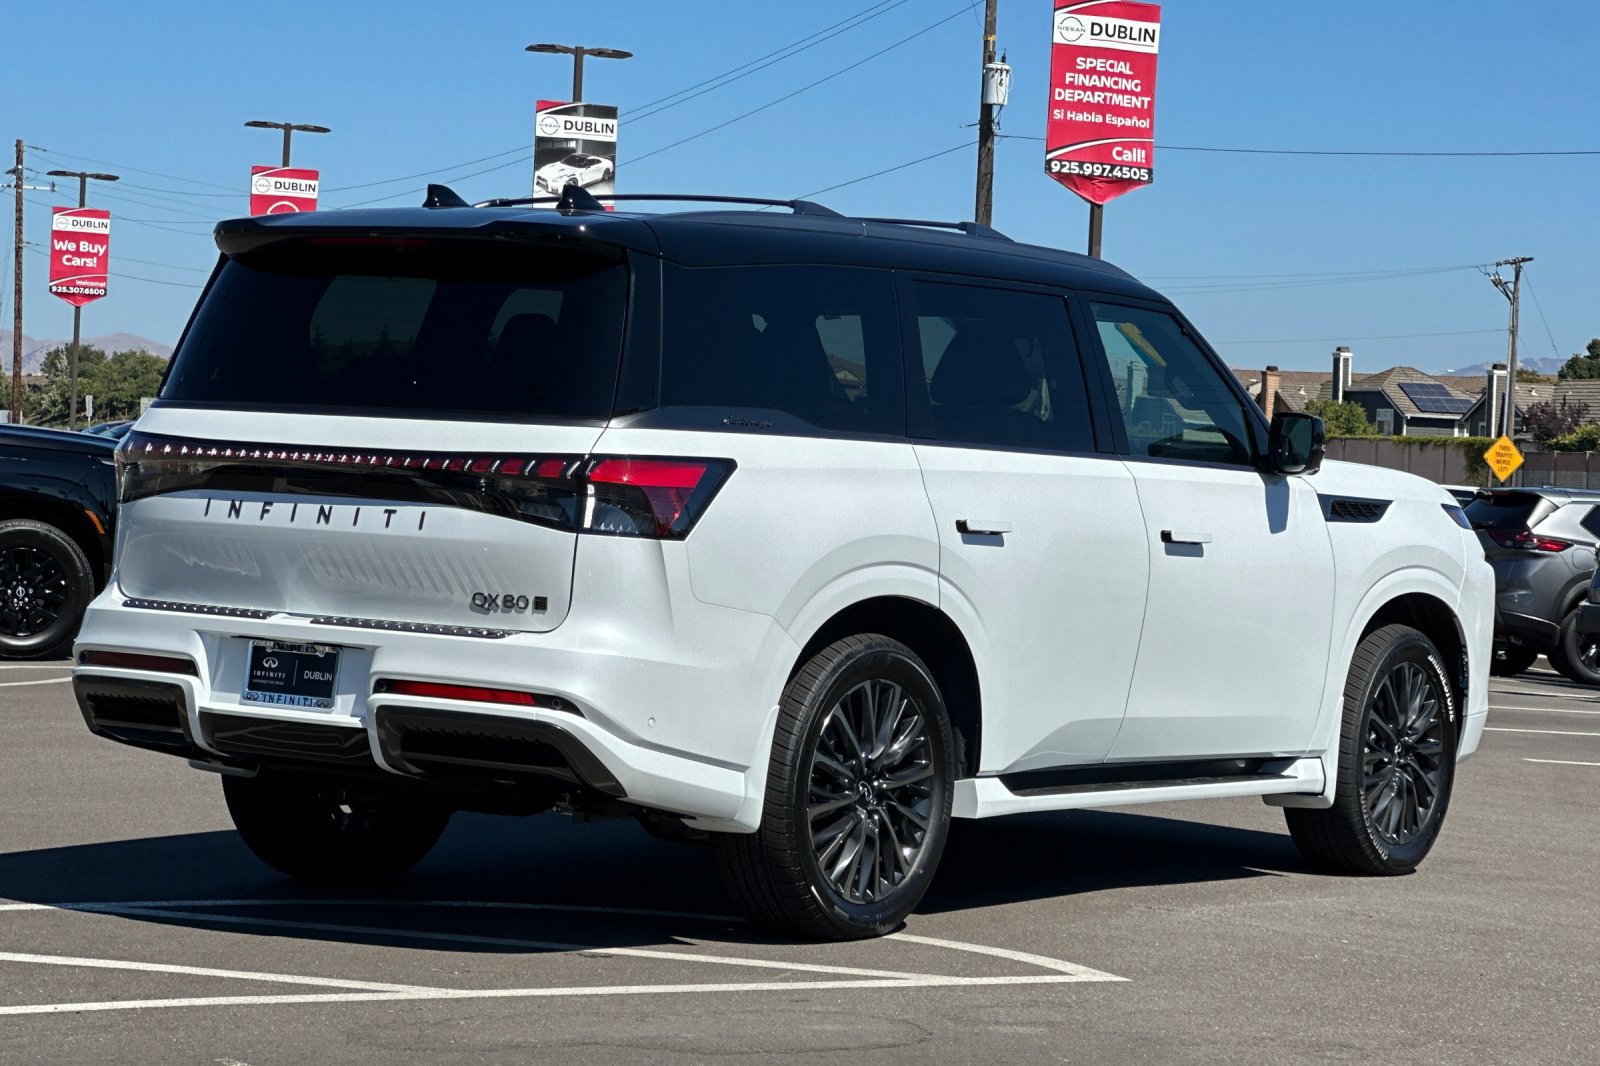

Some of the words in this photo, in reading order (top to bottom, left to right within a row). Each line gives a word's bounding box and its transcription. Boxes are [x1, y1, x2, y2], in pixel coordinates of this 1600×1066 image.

[1090, 22, 1156, 43] DUBLIN
[1076, 57, 1133, 75] SPECIAL
[1065, 72, 1141, 92] FINANCING
[1054, 88, 1151, 109] DEPARTMENT
[564, 120, 614, 134] DUBLIN
[1053, 109, 1064, 120] Si
[1067, 110, 1103, 123] Habla
[1105, 114, 1150, 128] Español
[1112, 147, 1146, 163] Call!
[1050, 161, 1149, 180] 925.997.4505
[274, 181, 316, 193] DUBLIN
[72, 220, 108, 229] DUBLIN
[53, 239, 76, 251] We
[79, 241, 107, 256] Buy
[62, 254, 97, 267] Cars!
[51, 286, 105, 295] 925.307.6500
[204, 497, 426, 531] INFINITI
[472, 592, 529, 611] QX80
[253, 670, 286, 679] INFINITI
[303, 670, 333, 681] DUBLIN
[263, 692, 313, 708] INFINITI
[1360, 787, 1388, 861] BRIDGESTONE
